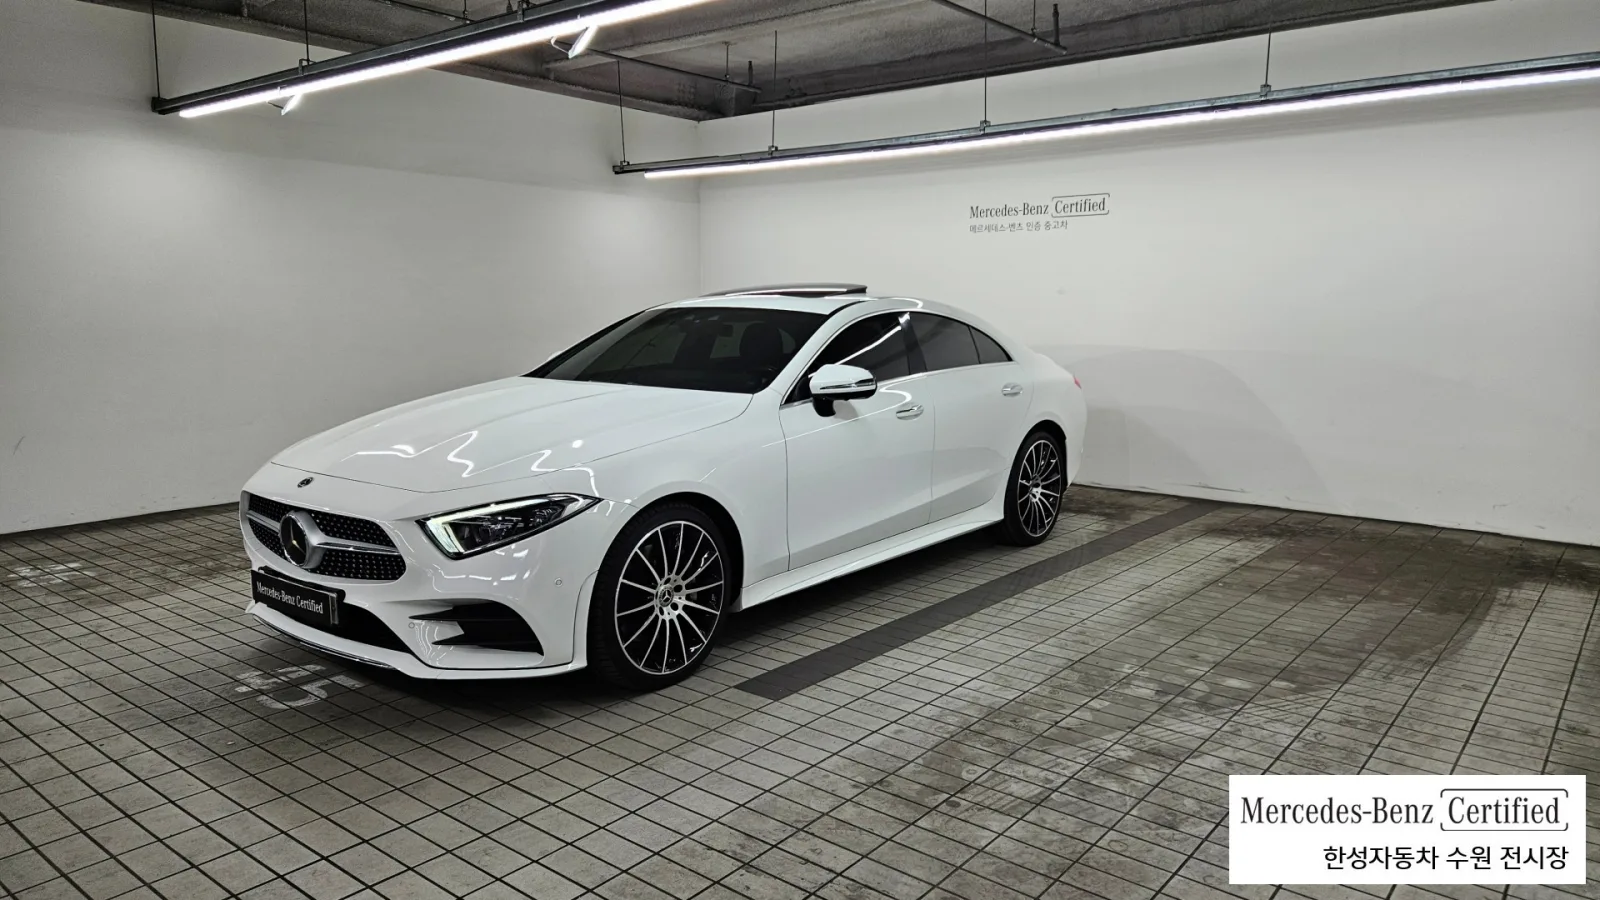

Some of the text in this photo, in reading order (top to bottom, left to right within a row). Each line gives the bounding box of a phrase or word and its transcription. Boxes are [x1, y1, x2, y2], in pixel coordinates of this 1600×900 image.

[969, 197, 1106, 219] Mercedes-Benz Certified
[1026, 221, 1041, 232] 인증
[1044, 219, 1068, 232] 중고차
[256, 581, 324, 614] Mercedes-Benz Certified
[235, 664, 362, 710] 45
